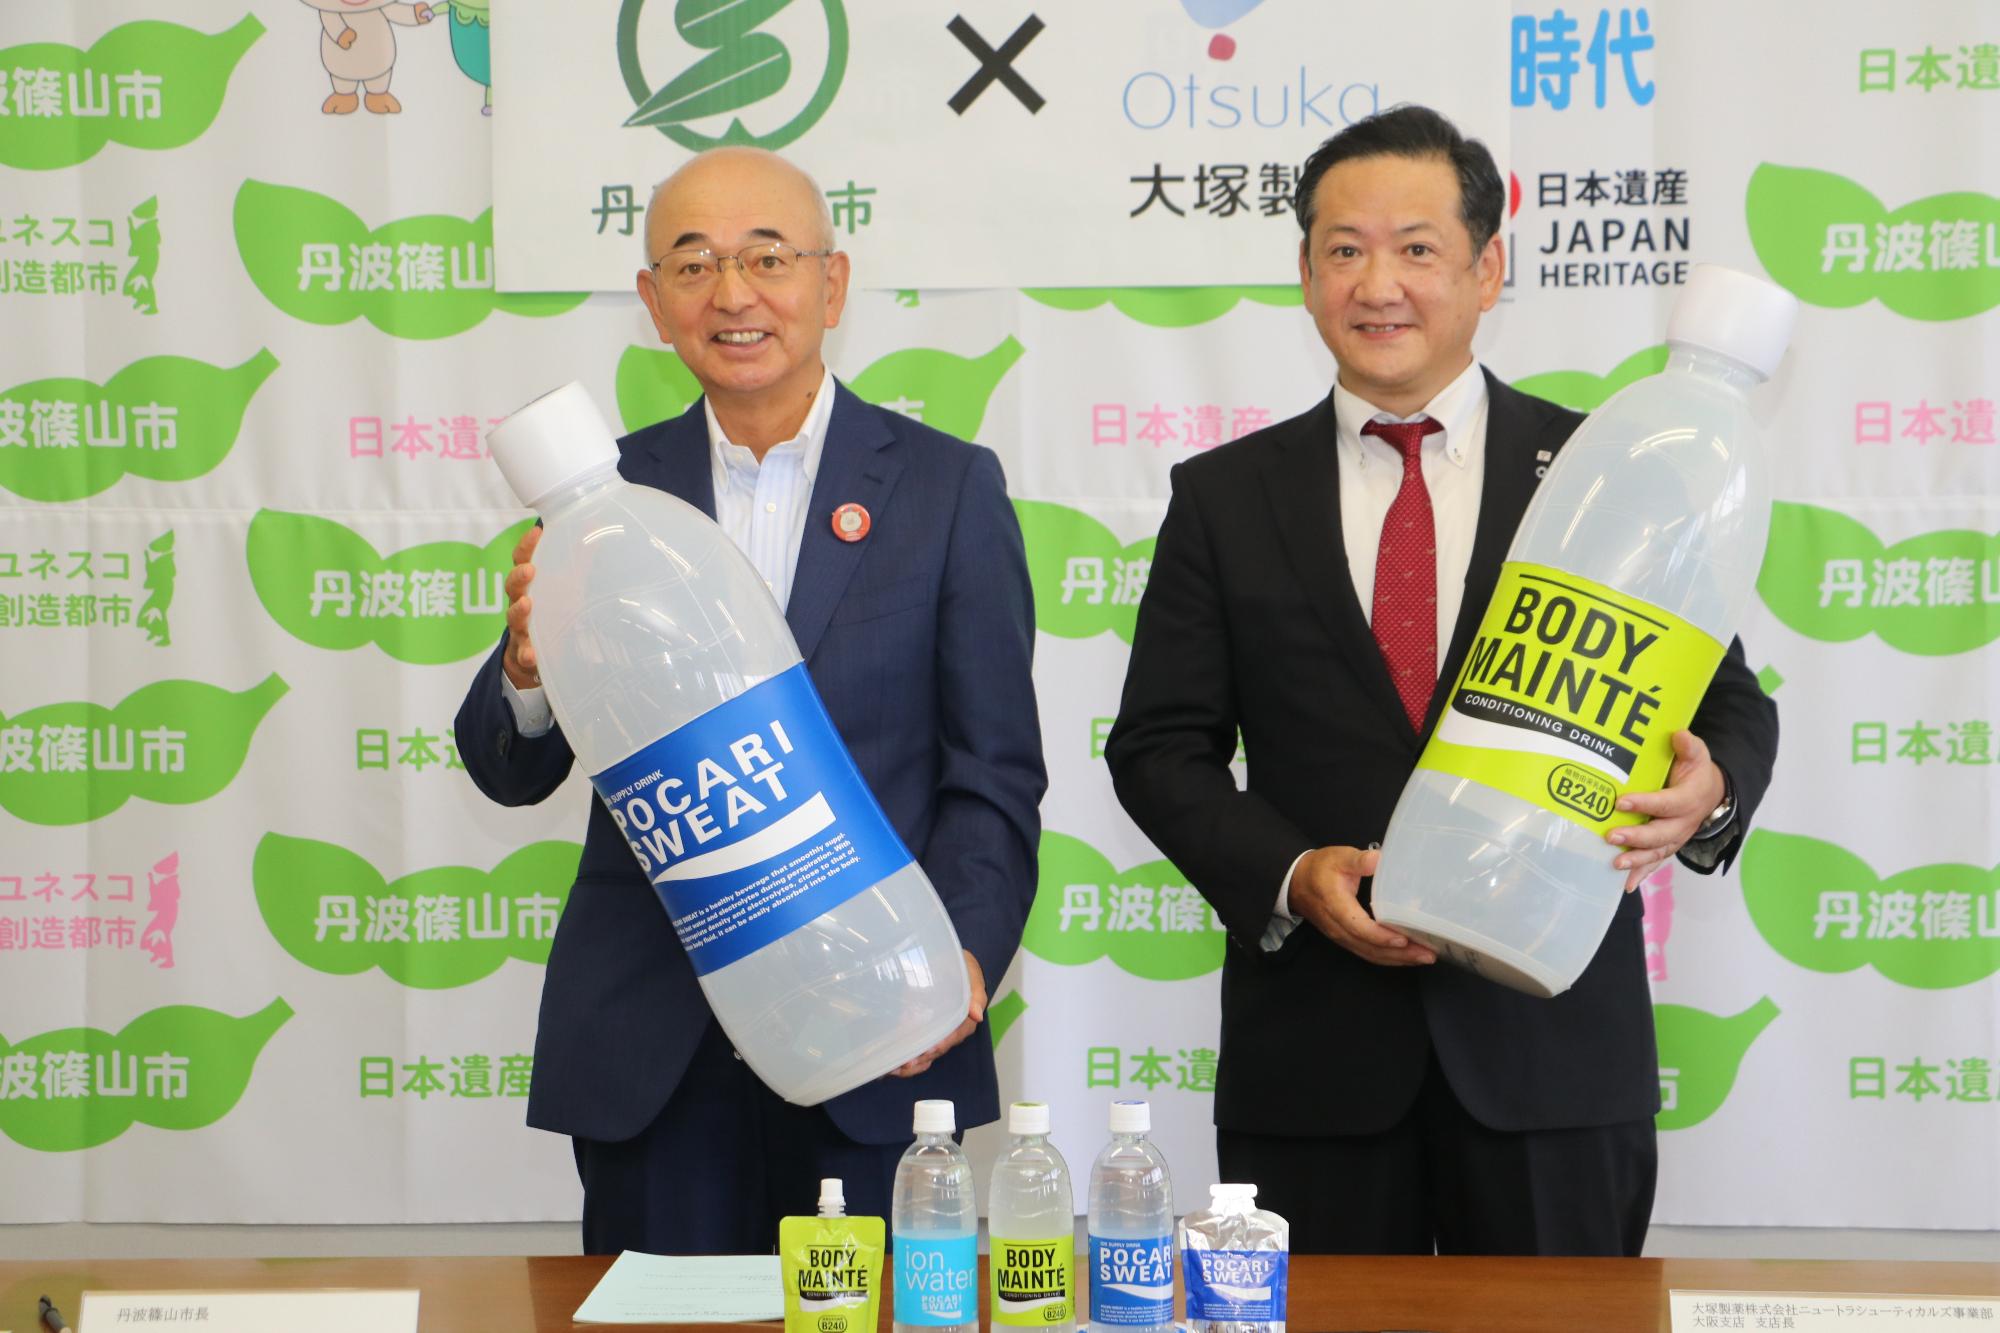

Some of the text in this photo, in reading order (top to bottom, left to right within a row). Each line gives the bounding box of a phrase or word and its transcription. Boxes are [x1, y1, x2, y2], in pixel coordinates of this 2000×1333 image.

[1511, 8, 1655, 110] 時代
[0, 66, 163, 120] 篠山市
[1122, 65, 1379, 129] Otsuka
[1538, 168, 1689, 208] 日本遺産
[0, 213, 115, 248] ネスコ
[1540, 217, 1691, 254] JAPAN
[0, 259, 119, 297] 造都市
[1540, 261, 1690, 287] HERITAGE
[348, 414, 509, 461] 日本遺
[1504, 586, 1660, 675] BODY
[1465, 636, 1662, 747] MAINTÉ
[1464, 693, 1616, 757] CONDITIONING DRINK
[609, 719, 795, 842] POCARI
[610, 784, 635, 804] SUPPLY
[633, 769, 665, 792] DRINK
[1555, 775, 1610, 816] B240
[629, 761, 786, 875] SWEAT
[706, 912, 719, 924] and
[718, 891, 761, 917] electrolytes
[760, 880, 787, 897] during
[786, 851, 836, 882] perspiration.
[835, 840, 852, 853] With
[708, 917, 732, 932] density
[732, 908, 747, 921] and
[746, 881, 798, 913] electrolytes,
[797, 868, 821, 885] close
[821, 862, 830, 872] to
[830, 852, 848, 866] that
[847, 846, 857, 856] of
[709, 894, 736, 913] healthy
[734, 875, 770, 899] beverage
[770, 864, 788, 879] that
[789, 845, 825, 869] smoothly
[824, 832, 847, 850] suppl-
[724, 923, 738, 935] can
[736, 916, 748, 928] be
[747, 905, 771, 923] easily
[770, 884, 810, 910] absorbed
[809, 873, 827, 889] into
[826, 866, 842, 879] the
[841, 855, 862, 873] body.
[313, 891, 562, 944] 丹波篠山市
[359, 1053, 534, 1101] 日本遺産
[798, 1264, 868, 1289] MAINTÉ
[809, 1248, 857, 1269] BODY
[905, 1244, 944, 1271] ion
[997, 1262, 1065, 1290] MAINTÉ
[1006, 1247, 1056, 1268] BODY
[1100, 1262, 1171, 1282] SWEAT
[1202, 1259, 1269, 1272] POCARI
[904, 1267, 975, 1292] water
[1203, 1271, 1263, 1284] SWEAT
[117, 1306, 209, 1322] 丹波篠山市長
[821, 1320, 845, 1331] B240
[1692, 1315, 1796, 1329] 大阪支店 支店長
